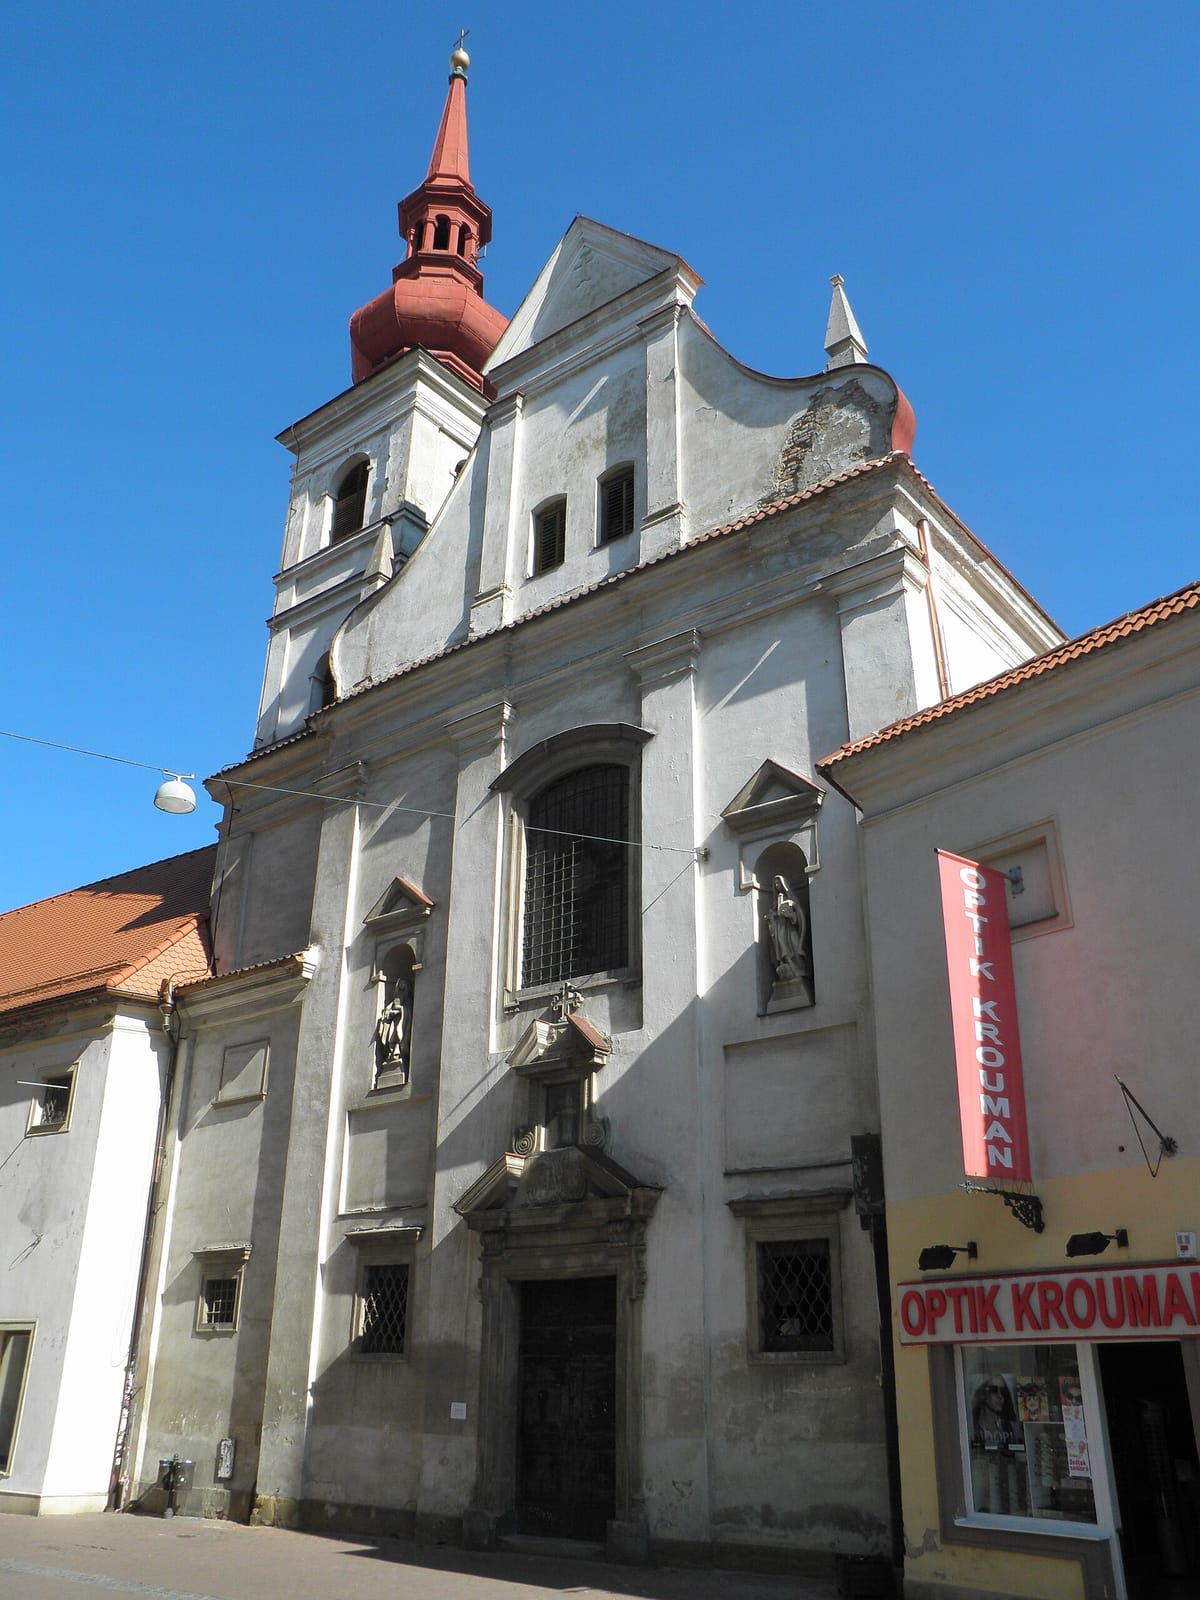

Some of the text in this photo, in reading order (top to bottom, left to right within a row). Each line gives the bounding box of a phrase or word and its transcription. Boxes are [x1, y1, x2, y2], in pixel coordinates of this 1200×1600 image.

[959, 867, 1013, 1170] OPTIK KROUMAN
[900, 1283, 1004, 1337] OPTIK
